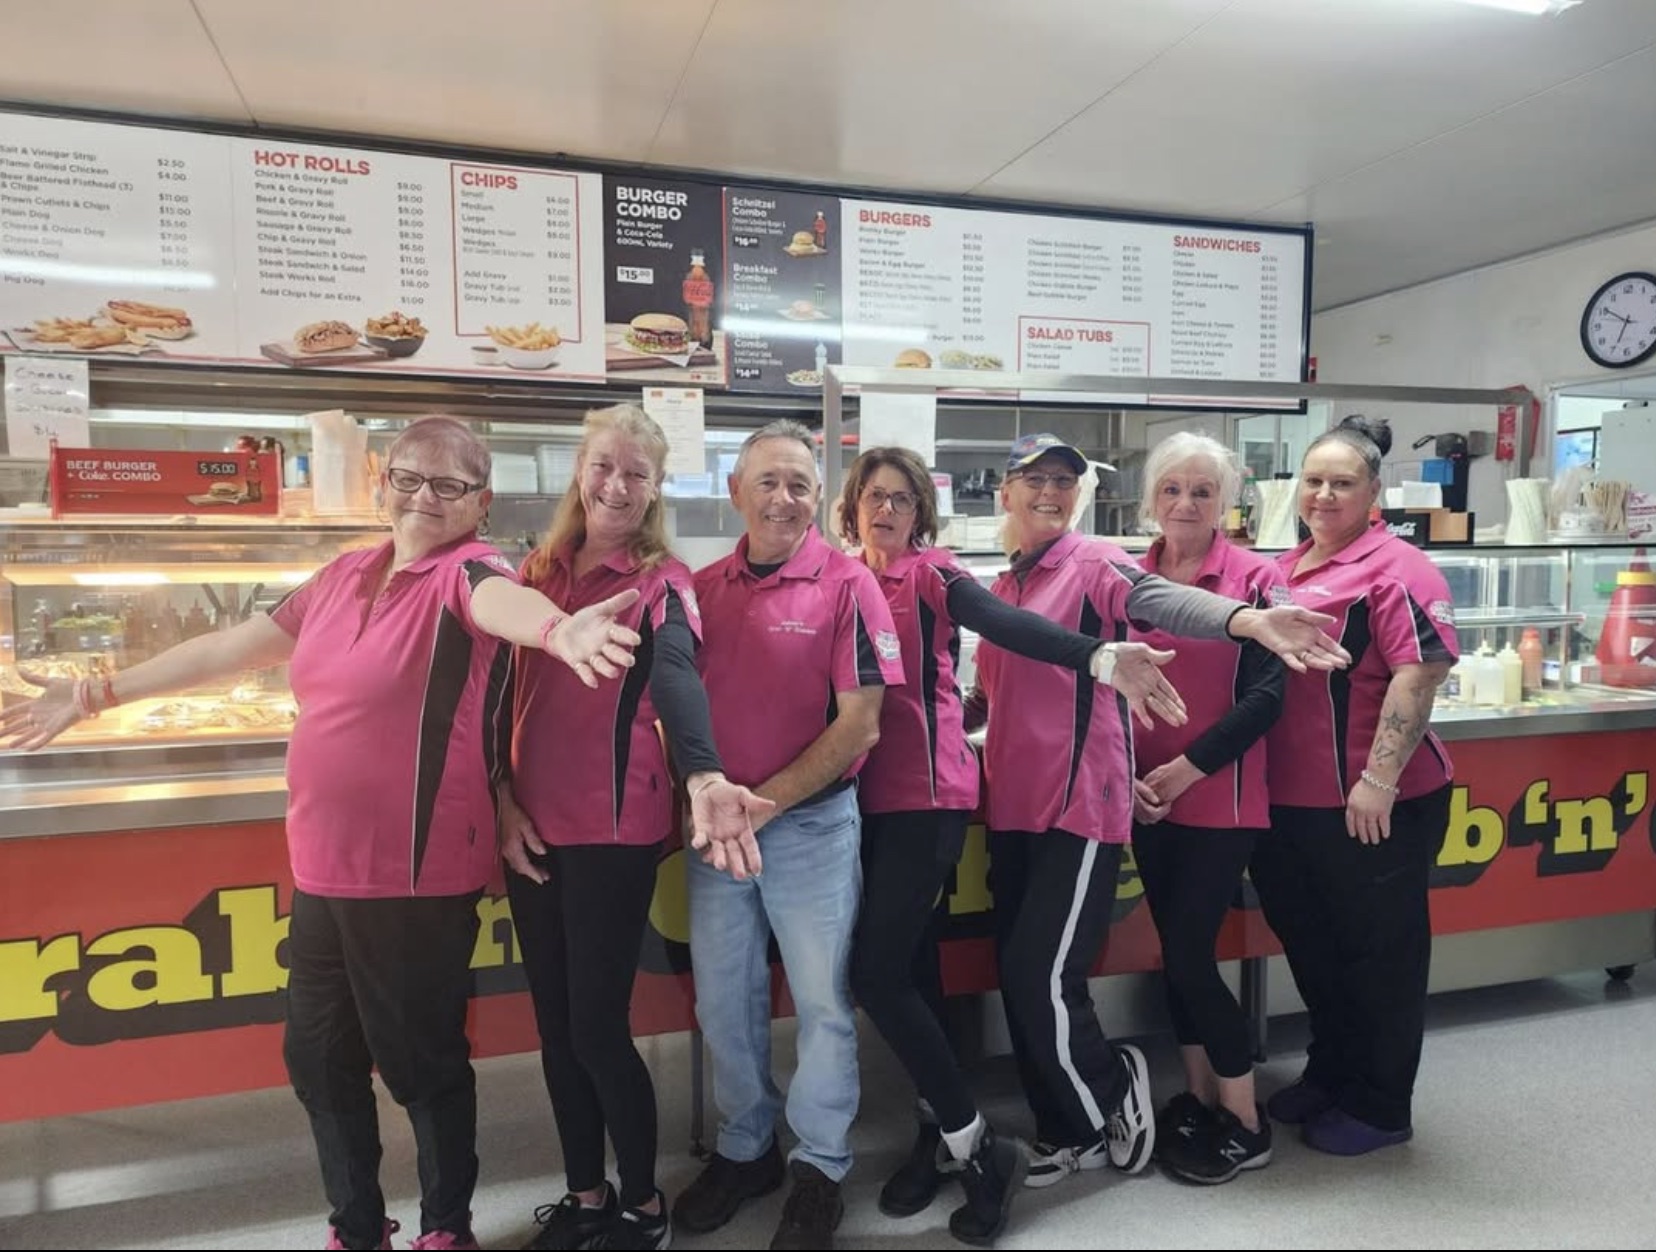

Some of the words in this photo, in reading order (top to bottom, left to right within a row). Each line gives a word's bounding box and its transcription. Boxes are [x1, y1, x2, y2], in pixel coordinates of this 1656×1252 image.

[31, 147, 69, 160] Vinegar
[33, 161, 67, 171] Grilled
[69, 164, 109, 175] Chicken
[158, 158, 185, 168] $2.50
[254, 150, 299, 169] HOT
[304, 155, 370, 175] ROLLS
[26, 173, 70, 185] Battered
[73, 178, 116, 189] Flathead
[254, 170, 291, 180] Chicken
[302, 174, 328, 184] Gravy
[330, 176, 348, 185] Roll
[460, 171, 518, 190] CHIPS
[10, 182, 39, 192] Chips
[255, 182, 276, 191] Pork
[287, 185, 314, 196] Gravy
[316, 187, 334, 196] Roll
[460, 190, 484, 198] Small
[616, 186, 688, 207] BURGER
[34, 197, 70, 207] Cutlets
[83, 200, 110, 211] Chips
[256, 194, 277, 204] Beef
[288, 197, 314, 207] Gravy
[317, 199, 334, 209] Roll
[461, 202, 495, 211] Medium
[731, 197, 776, 210] Schnitzel
[1, 208, 27, 218] Plain
[29, 209, 50, 220] Dog
[299, 211, 326, 222] Gravy
[328, 213, 346, 222] Roll
[616, 202, 682, 221] COMBO
[731, 206, 767, 218] Combo
[859, 208, 932, 228] BURGERS
[462, 213, 486, 224] Large
[616, 219, 636, 228] Plain
[637, 221, 664, 231] Burger
[1, 221, 39, 230] Cheese
[51, 225, 82, 234] Onion
[84, 227, 105, 238] Dog
[256, 220, 295, 231] Sausage
[305, 224, 332, 234] Gravy
[334, 226, 352, 235] Roll
[462, 226, 496, 237] Wedges
[616, 228, 623, 237] &
[624, 228, 664, 240] Coca-Cola
[257, 233, 279, 243] Chip
[289, 235, 316, 246] Gravy
[318, 237, 336, 247] Roll
[462, 238, 496, 249] Wedges
[646, 240, 674, 251] Variety
[1172, 235, 1261, 253] SANDWICHES
[257, 245, 283, 255] Steak
[285, 247, 330, 258] Sandwich
[340, 251, 367, 261] Onion
[258, 258, 284, 267] Steak
[286, 260, 330, 270] Sandwich
[340, 264, 365, 273] Salad
[733, 263, 778, 275] Breakfast
[259, 270, 284, 280] Steak
[287, 273, 316, 282] Works
[318, 274, 336, 284] Roll
[463, 270, 481, 279] Add
[483, 271, 507, 281] Gravy
[733, 273, 769, 284] Combo
[464, 281, 488, 292] Gravy
[490, 283, 506, 292] Tub
[260, 287, 279, 297] Add
[281, 289, 307, 300] Chips
[309, 290, 322, 300] for
[337, 293, 361, 302] Extra
[464, 293, 488, 304] Gravy
[490, 295, 506, 304] Tub
[1027, 326, 1073, 341] SALAD
[1076, 328, 1113, 343] TUBS
[735, 338, 769, 349] Combo
[66, 460, 100, 471] BEEF
[103, 461, 158, 472] BURGER
[68, 472, 75, 480] +
[112, 471, 163, 482] COMBO
